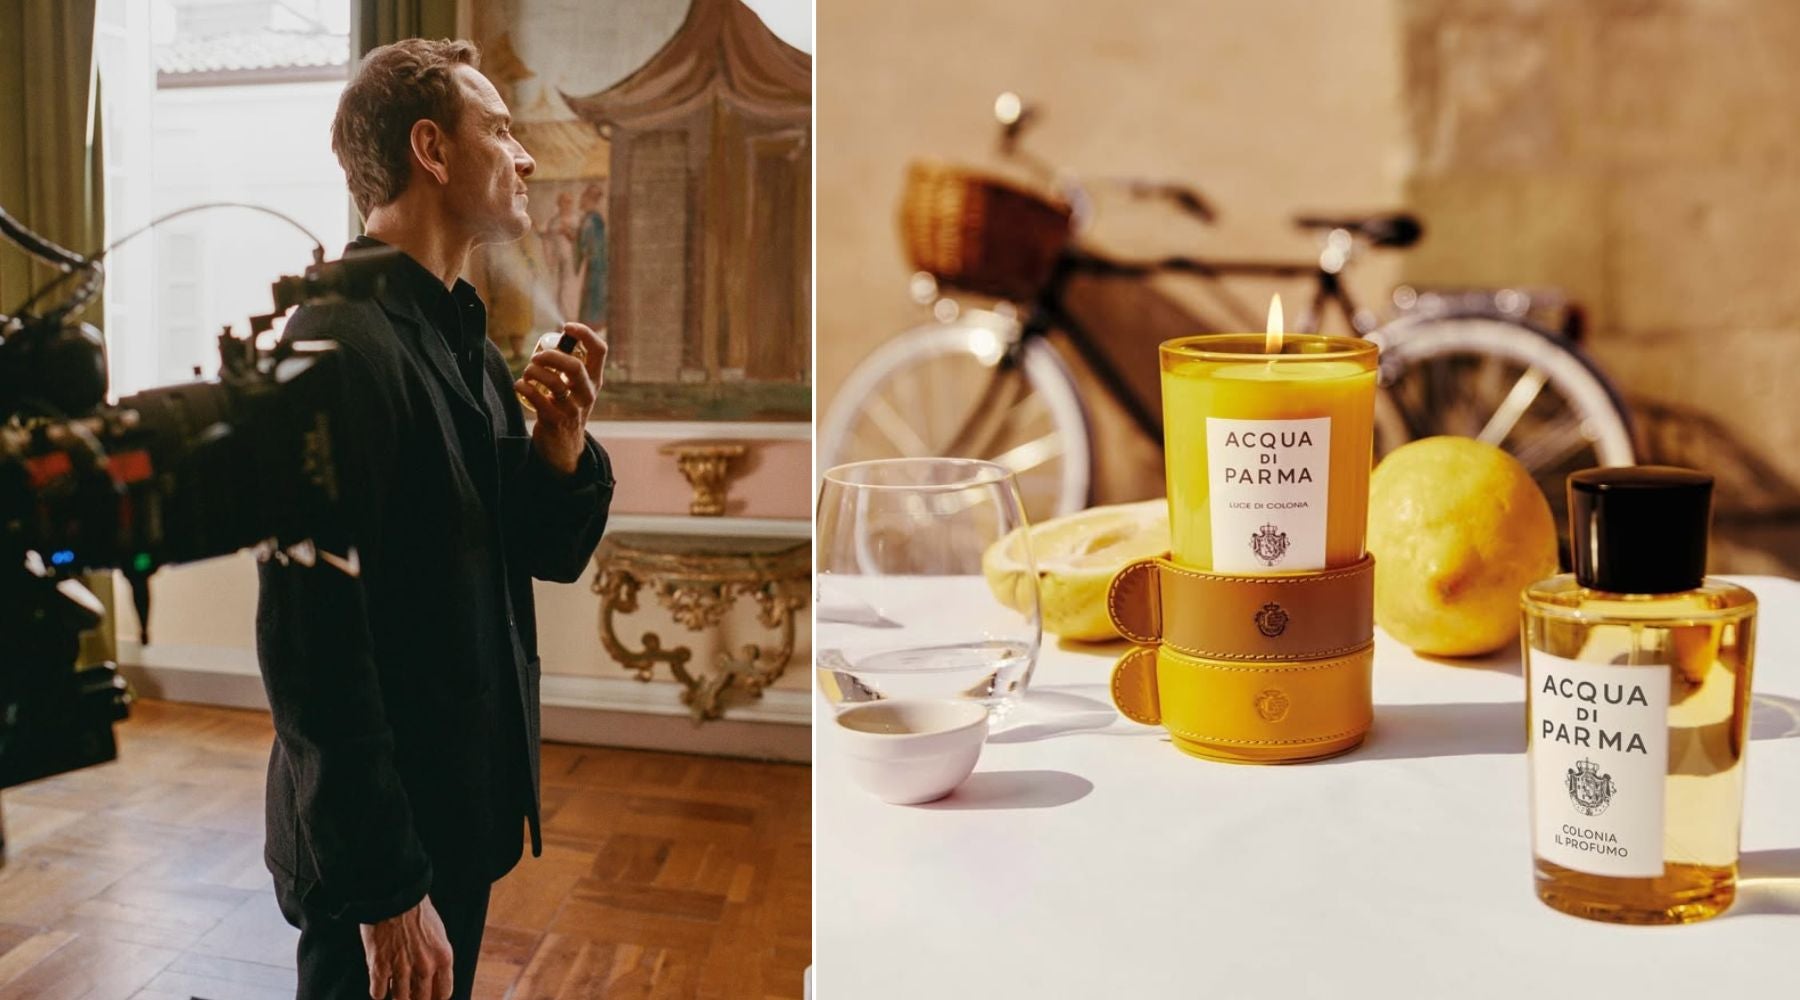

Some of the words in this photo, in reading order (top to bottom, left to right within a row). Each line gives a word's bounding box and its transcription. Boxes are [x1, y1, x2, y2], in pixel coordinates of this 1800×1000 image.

[1225, 431, 1313, 450] ACQUA
[1260, 453, 1277, 464] DI
[1225, 467, 1313, 485] PARMA
[1229, 502, 1251, 510] LUCE
[1254, 502, 1264, 510] DI
[1266, 501, 1309, 510] COLONIA
[1542, 674, 1649, 707] ACQUA
[1576, 707, 1598, 723] DI
[1542, 719, 1648, 755] PARMA
[1562, 823, 1618, 844] COLONIA
[1555, 834, 1564, 846] IL
[1565, 837, 1629, 858] PROFUMO
